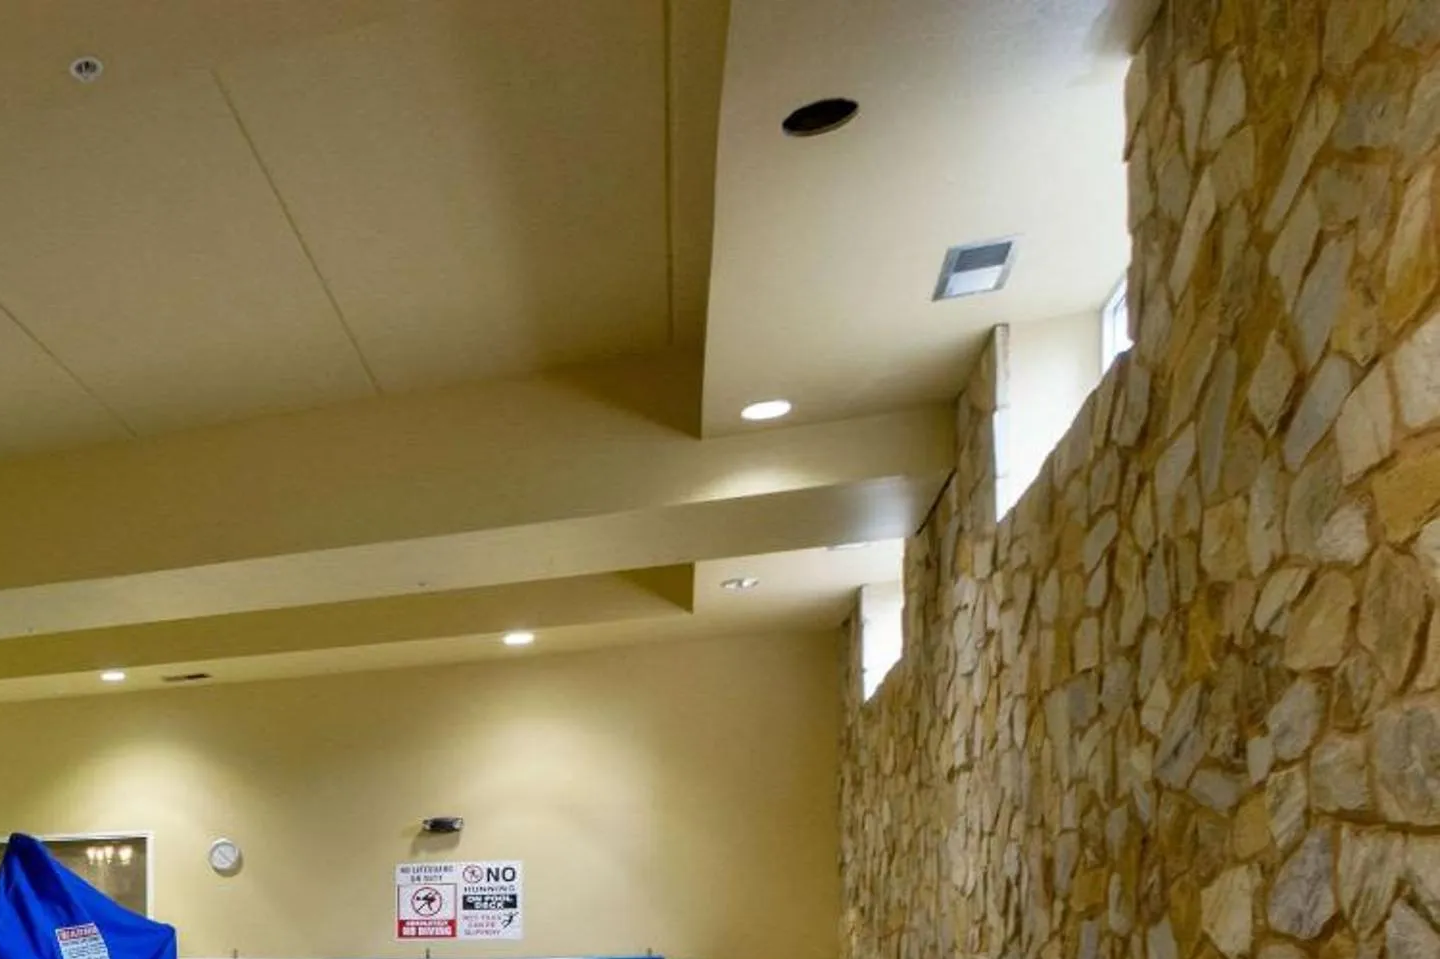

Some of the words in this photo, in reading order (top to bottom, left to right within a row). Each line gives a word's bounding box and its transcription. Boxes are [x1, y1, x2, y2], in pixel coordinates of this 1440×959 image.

[486, 867, 516, 882] NO
[464, 885, 516, 893] RUNNING
[474, 901, 504, 910] DECK
